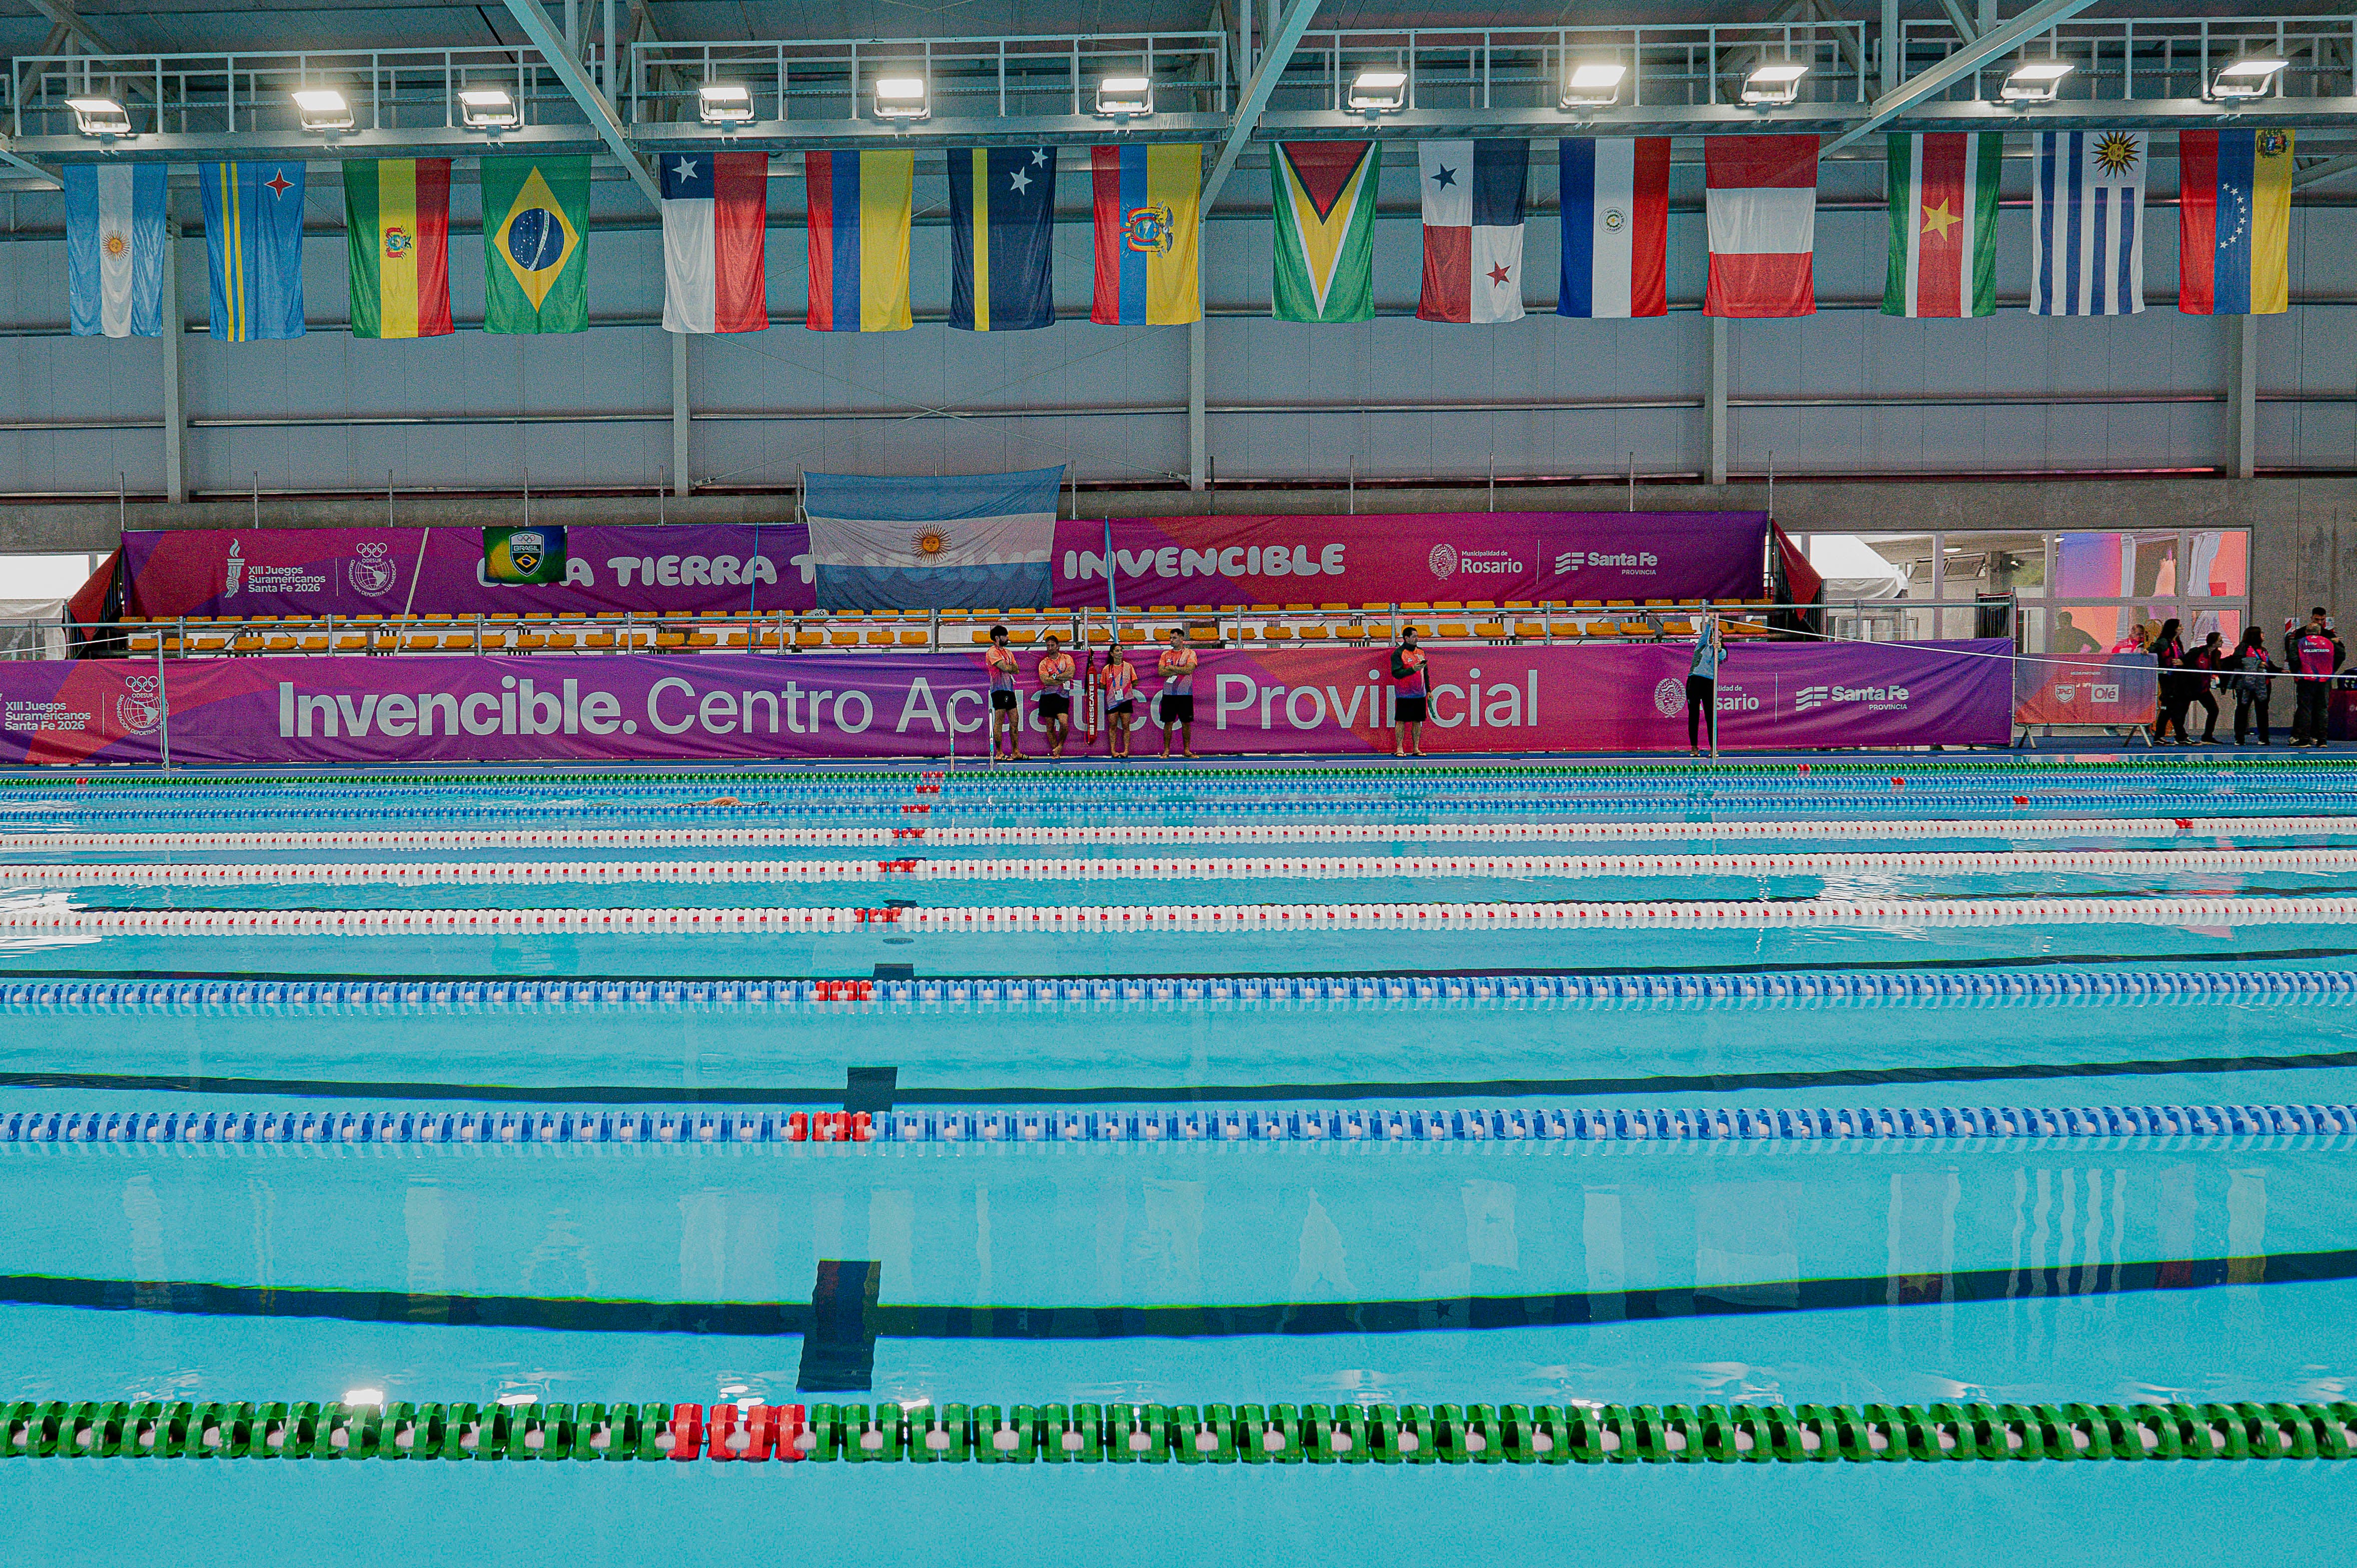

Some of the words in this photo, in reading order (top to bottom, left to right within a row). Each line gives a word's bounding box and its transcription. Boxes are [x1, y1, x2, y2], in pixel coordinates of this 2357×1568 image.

[607, 555, 778, 586] TIERRA
[1064, 543, 1346, 580] INVENCIBLE
[1461, 558, 1523, 573] Rosario
[1587, 552, 1637, 566] Santa
[1639, 552, 1657, 566] Fe
[248, 566, 263, 574] XIII
[265, 566, 303, 576] Juegos
[248, 574, 326, 583] Suramericanos
[248, 584, 277, 592] Santa
[280, 584, 293, 592] Fe
[1831, 686, 1886, 701] Santa
[1888, 685, 1909, 700] Fe
[2094, 687, 2116, 700] Olé
[5, 702, 23, 711] XIII
[25, 702, 66, 713] Juegos
[279, 675, 638, 737] Invencible.
[647, 677, 873, 735] Centro
[1216, 668, 1538, 730] Provicial
[1699, 694, 1759, 710] sario
[5, 710, 91, 721] Suramericanos
[4, 721, 38, 730] Santa
[41, 721, 55, 730] Fe
[57, 721, 85, 730] 2026
